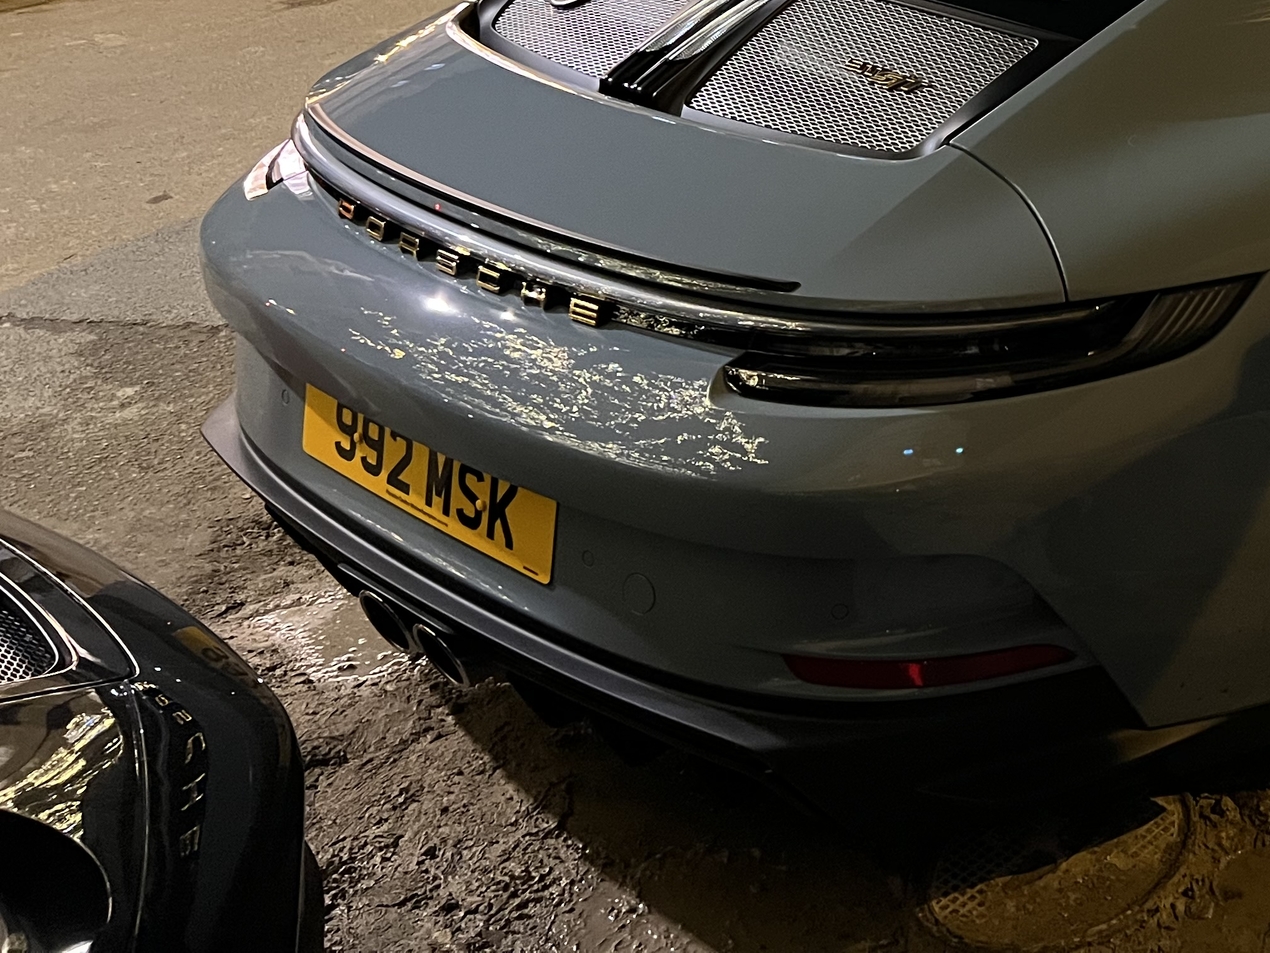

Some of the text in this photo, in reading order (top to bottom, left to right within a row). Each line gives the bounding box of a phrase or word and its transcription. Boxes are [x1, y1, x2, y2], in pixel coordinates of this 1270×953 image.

[337, 198, 602, 327] PORSCHE
[334, 400, 519, 551] 992 MSK
